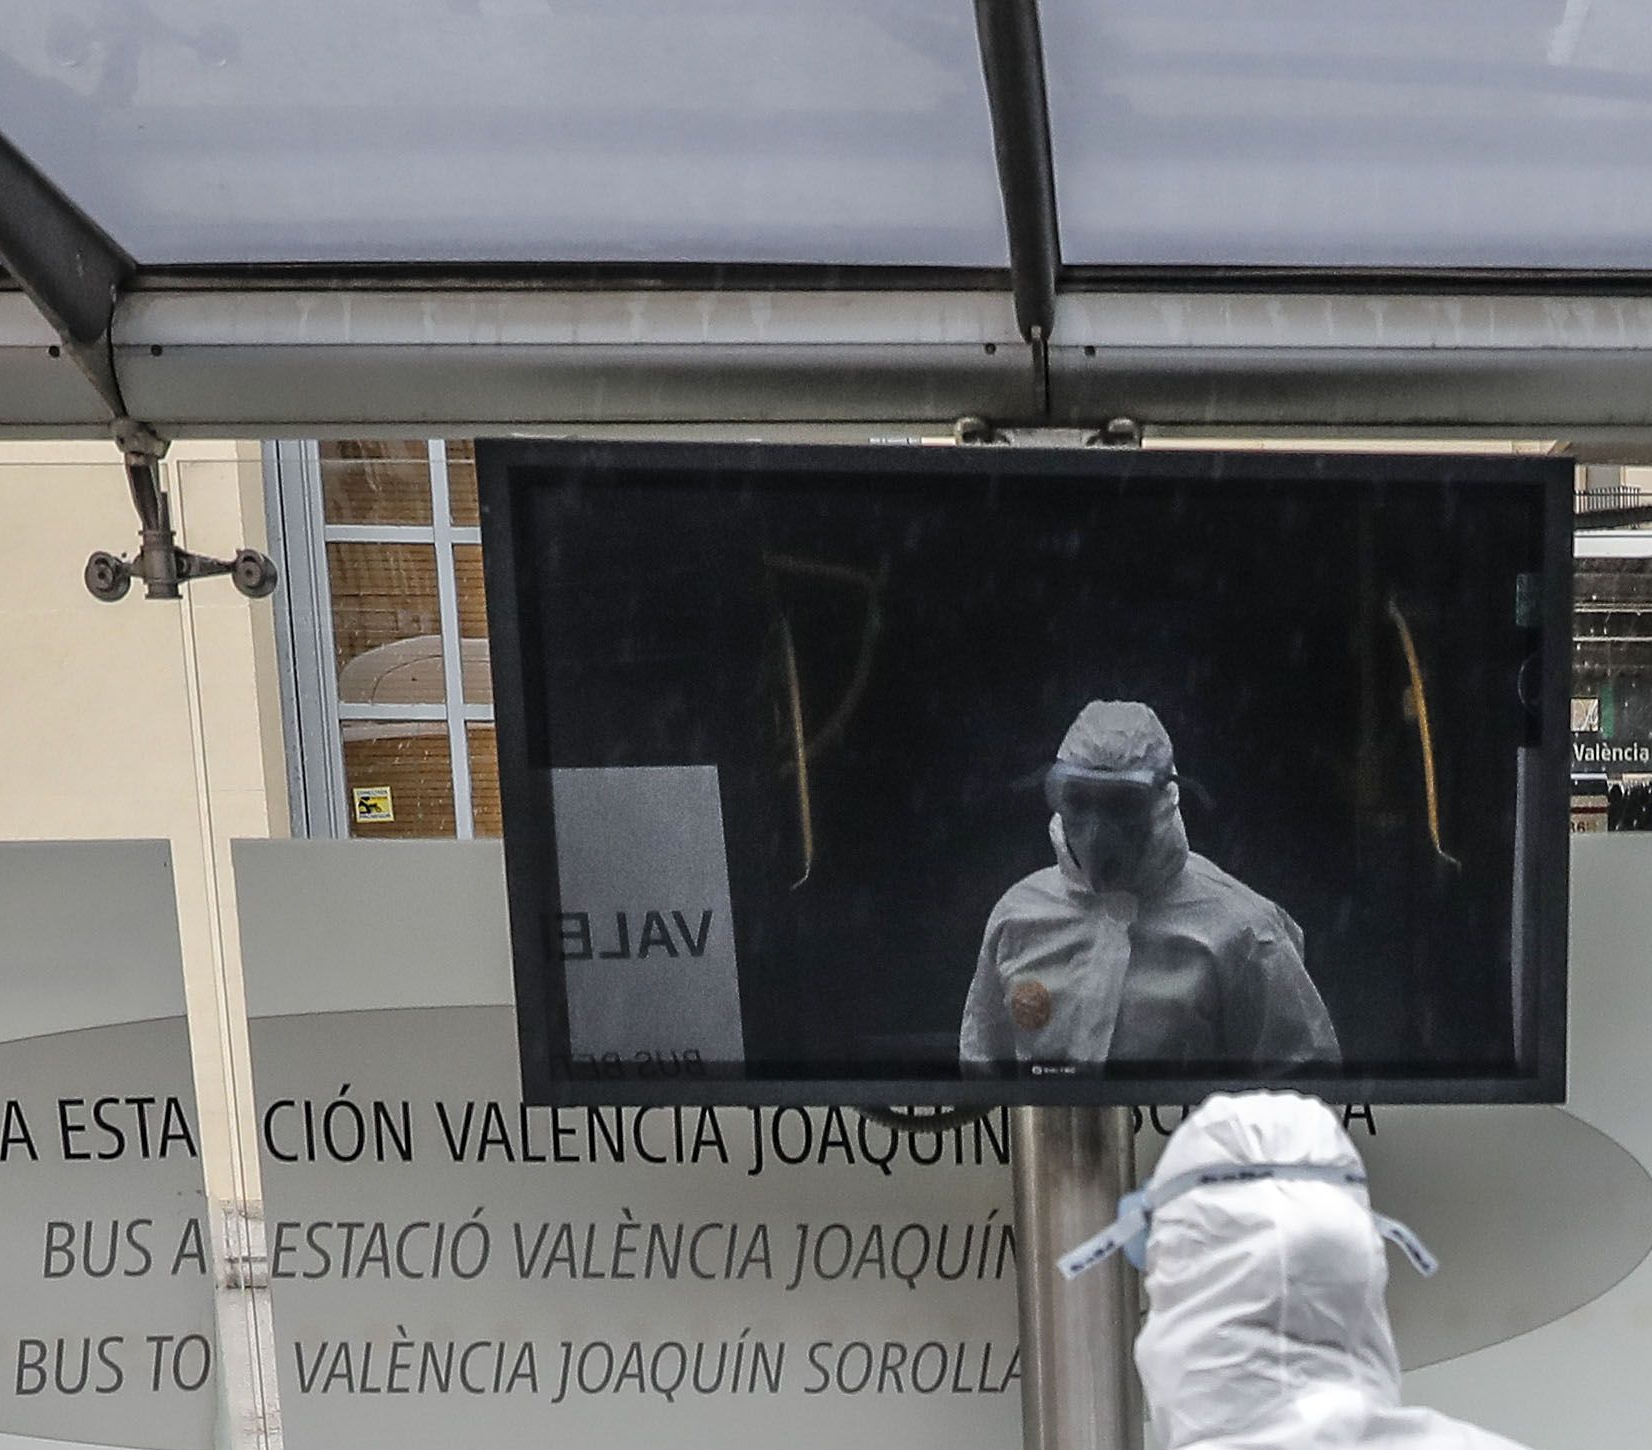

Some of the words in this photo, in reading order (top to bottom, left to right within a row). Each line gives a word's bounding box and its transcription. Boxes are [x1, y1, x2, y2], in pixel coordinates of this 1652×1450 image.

[1573, 741, 1649, 763] València
[42, 1217, 153, 1279] BUS
[171, 1216, 208, 1275] A
[270, 1207, 491, 1280] ESTACIÓ
[512, 1207, 774, 1280] VALÈNCIA
[14, 1335, 125, 1396] BUS
[147, 1334, 211, 1393] TO
[294, 1324, 540, 1394] VALÈNCIA
[550, 1327, 786, 1404] JOAQUÍN
